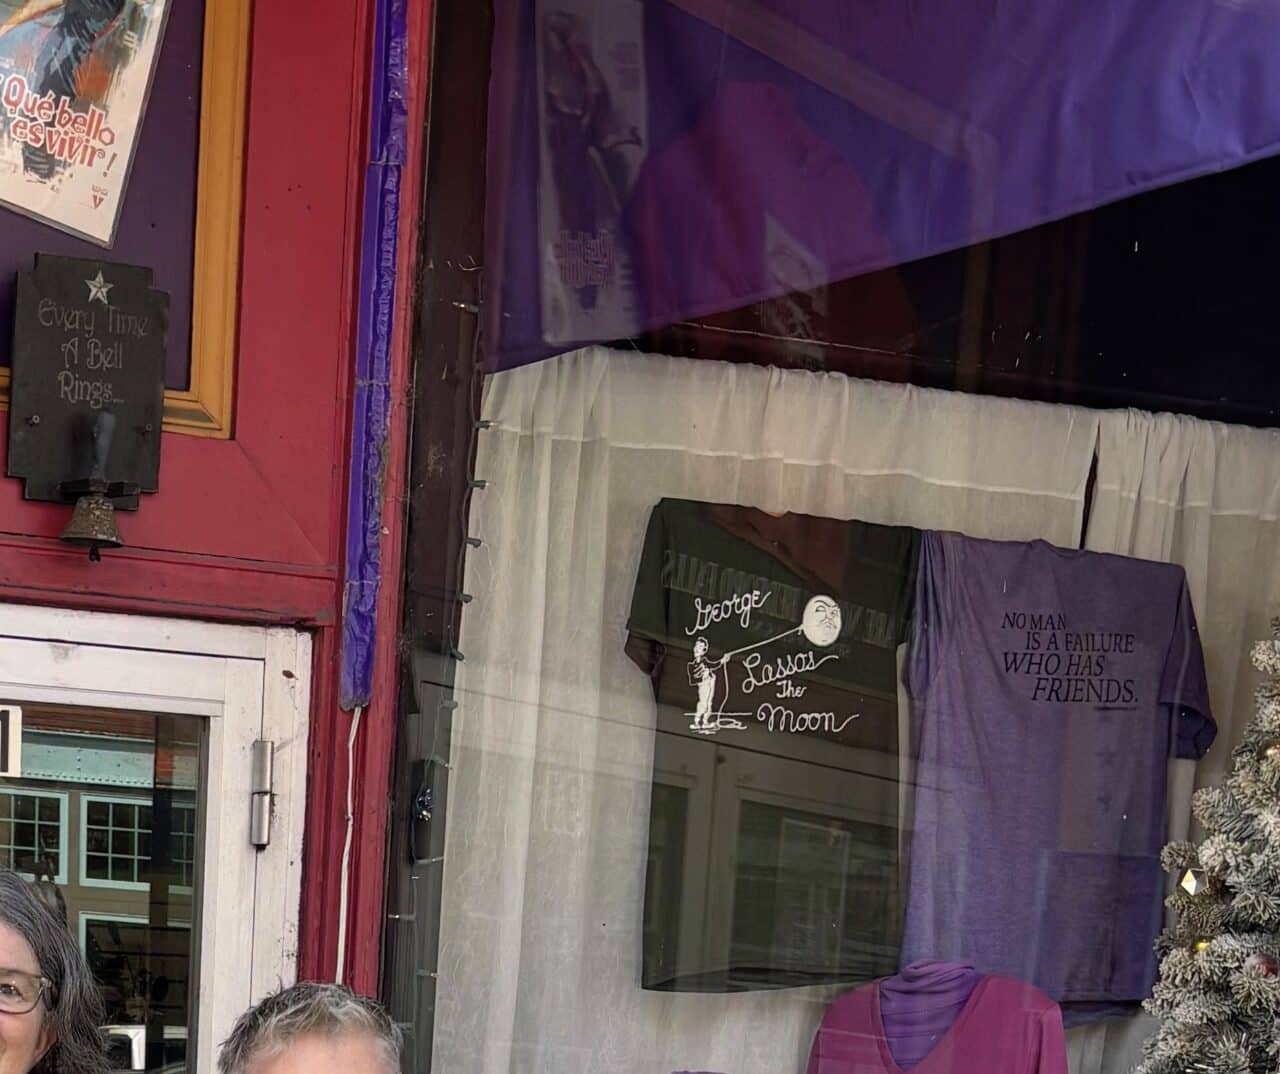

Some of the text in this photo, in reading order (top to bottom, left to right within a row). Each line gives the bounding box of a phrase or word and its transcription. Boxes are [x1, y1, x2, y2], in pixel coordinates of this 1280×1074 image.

[38, 298, 150, 338] Every Time
[61, 337, 123, 371] A Bell
[685, 590, 772, 635] George
[1001, 612, 1067, 631] NO MAN
[1025, 631, 1135, 653] IS A FAILURE
[742, 651, 839, 693] Lassos
[1003, 652, 1105, 676] WHO HAS
[776, 680, 807, 698] The
[1032, 677, 1138, 703] FRIENDS.
[757, 702, 860, 732] Moon
